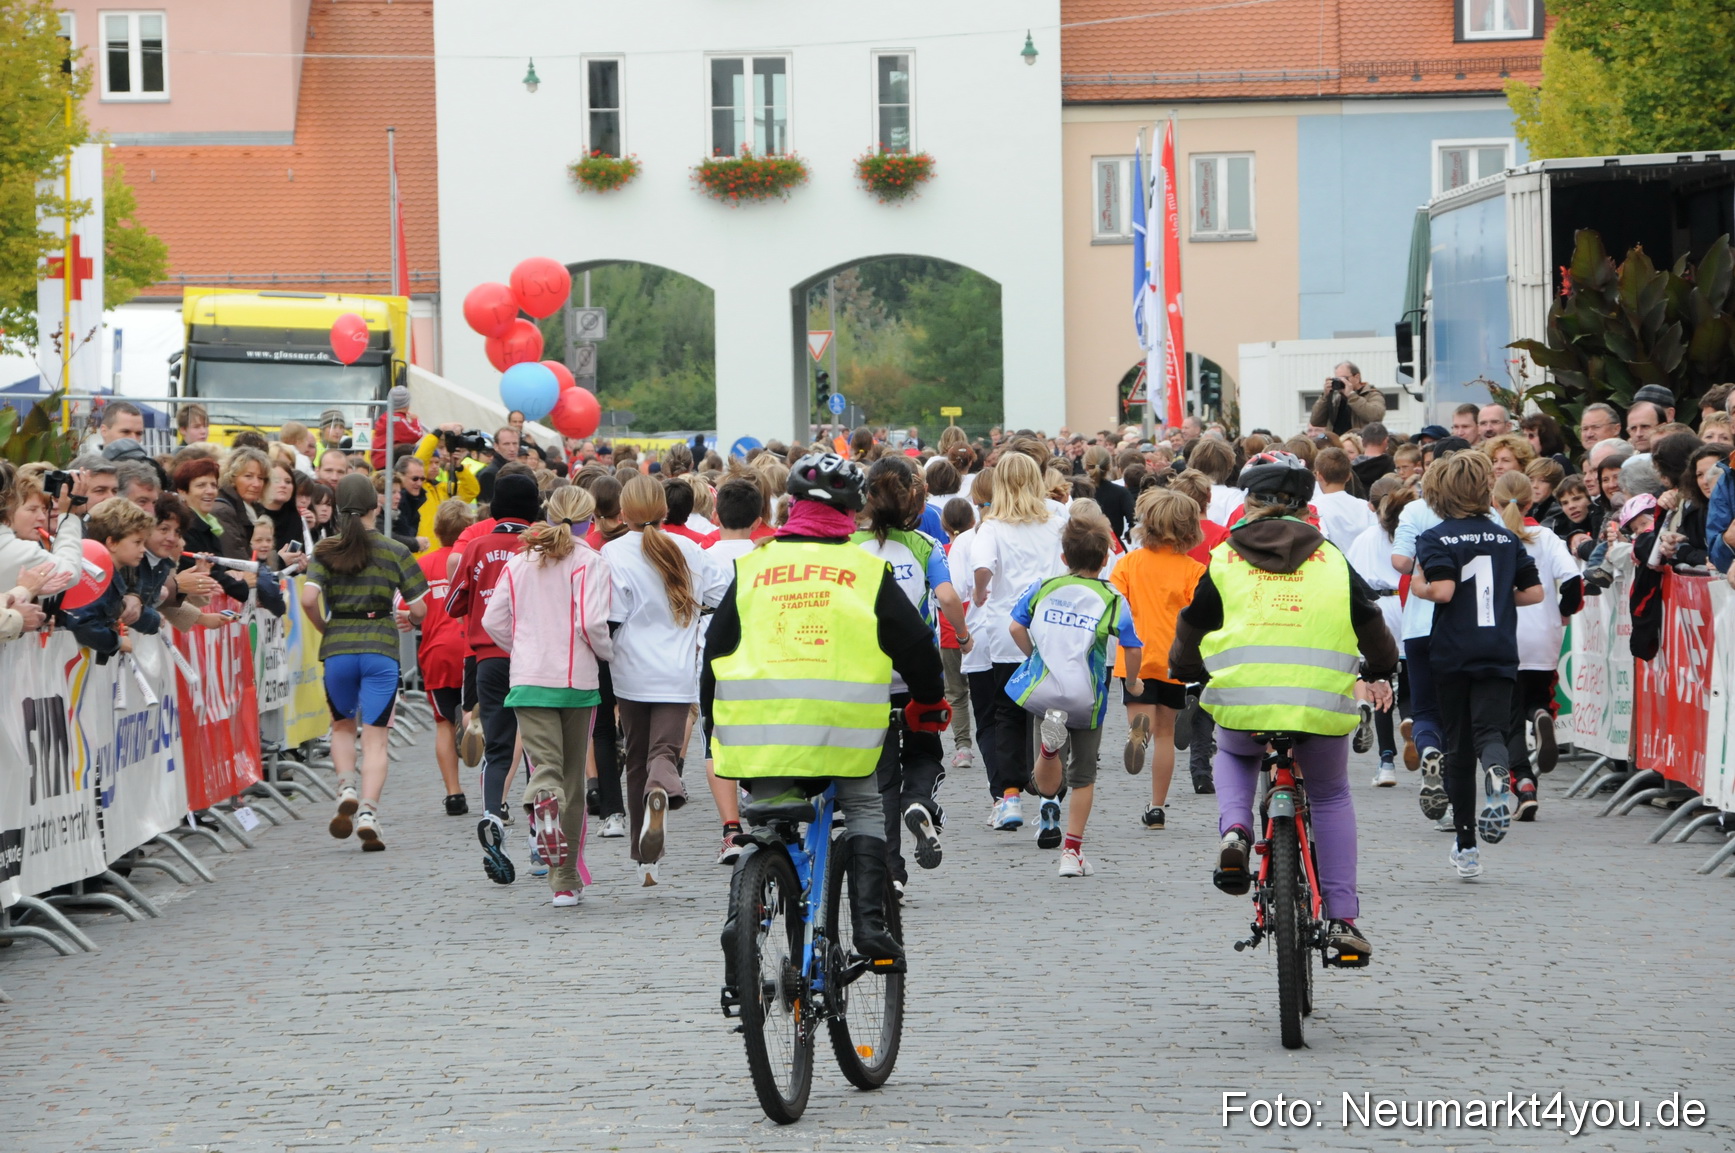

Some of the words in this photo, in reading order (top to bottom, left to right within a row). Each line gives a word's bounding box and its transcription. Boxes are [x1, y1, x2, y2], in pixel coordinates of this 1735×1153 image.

[1459, 533, 1481, 544] way
[1482, 531, 1495, 541] to
[1496, 533, 1512, 544] go.
[486, 549, 516, 563] NEUM
[752, 564, 857, 590] HELFER
[1257, 574, 1304, 582] STADTLAUF
[771, 590, 831, 603] NEUMARKTER
[1461, 555, 1496, 627] 1
[781, 600, 831, 610] STADTLAUF
[1044, 608, 1100, 632] BOCK
